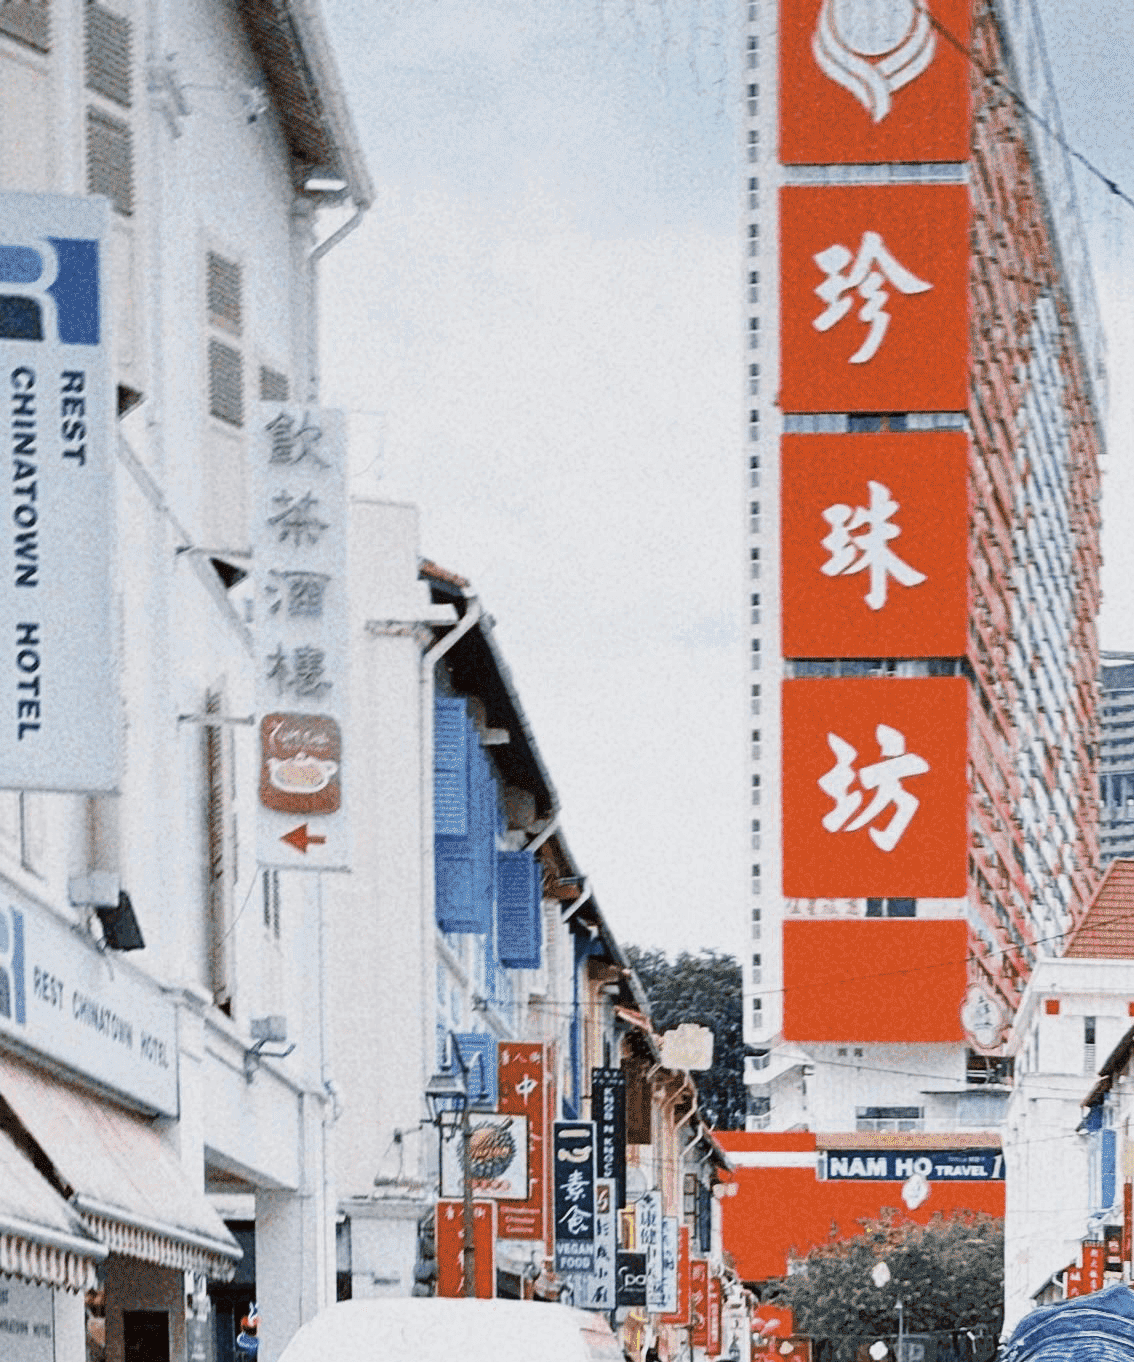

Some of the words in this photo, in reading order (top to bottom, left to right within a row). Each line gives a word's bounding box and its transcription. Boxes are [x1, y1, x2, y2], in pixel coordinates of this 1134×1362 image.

[60, 370, 87, 467] REST
[10, 366, 38, 588] CHINATOWN
[264, 410, 333, 697] 飲茶酒樓
[812, 231, 935, 854] 珍珠坊
[16, 623, 42, 741] HOTEL
[33, 964, 64, 1011] REST
[557, 1128, 592, 1236] 一心素食
[830, 1157, 887, 1177] NAM
[895, 1156, 933, 1177] HO
[934, 1165, 988, 1177] TRAVEL
[557, 1242, 594, 1255] VEGAN
[560, 1257, 591, 1269] FOOD
